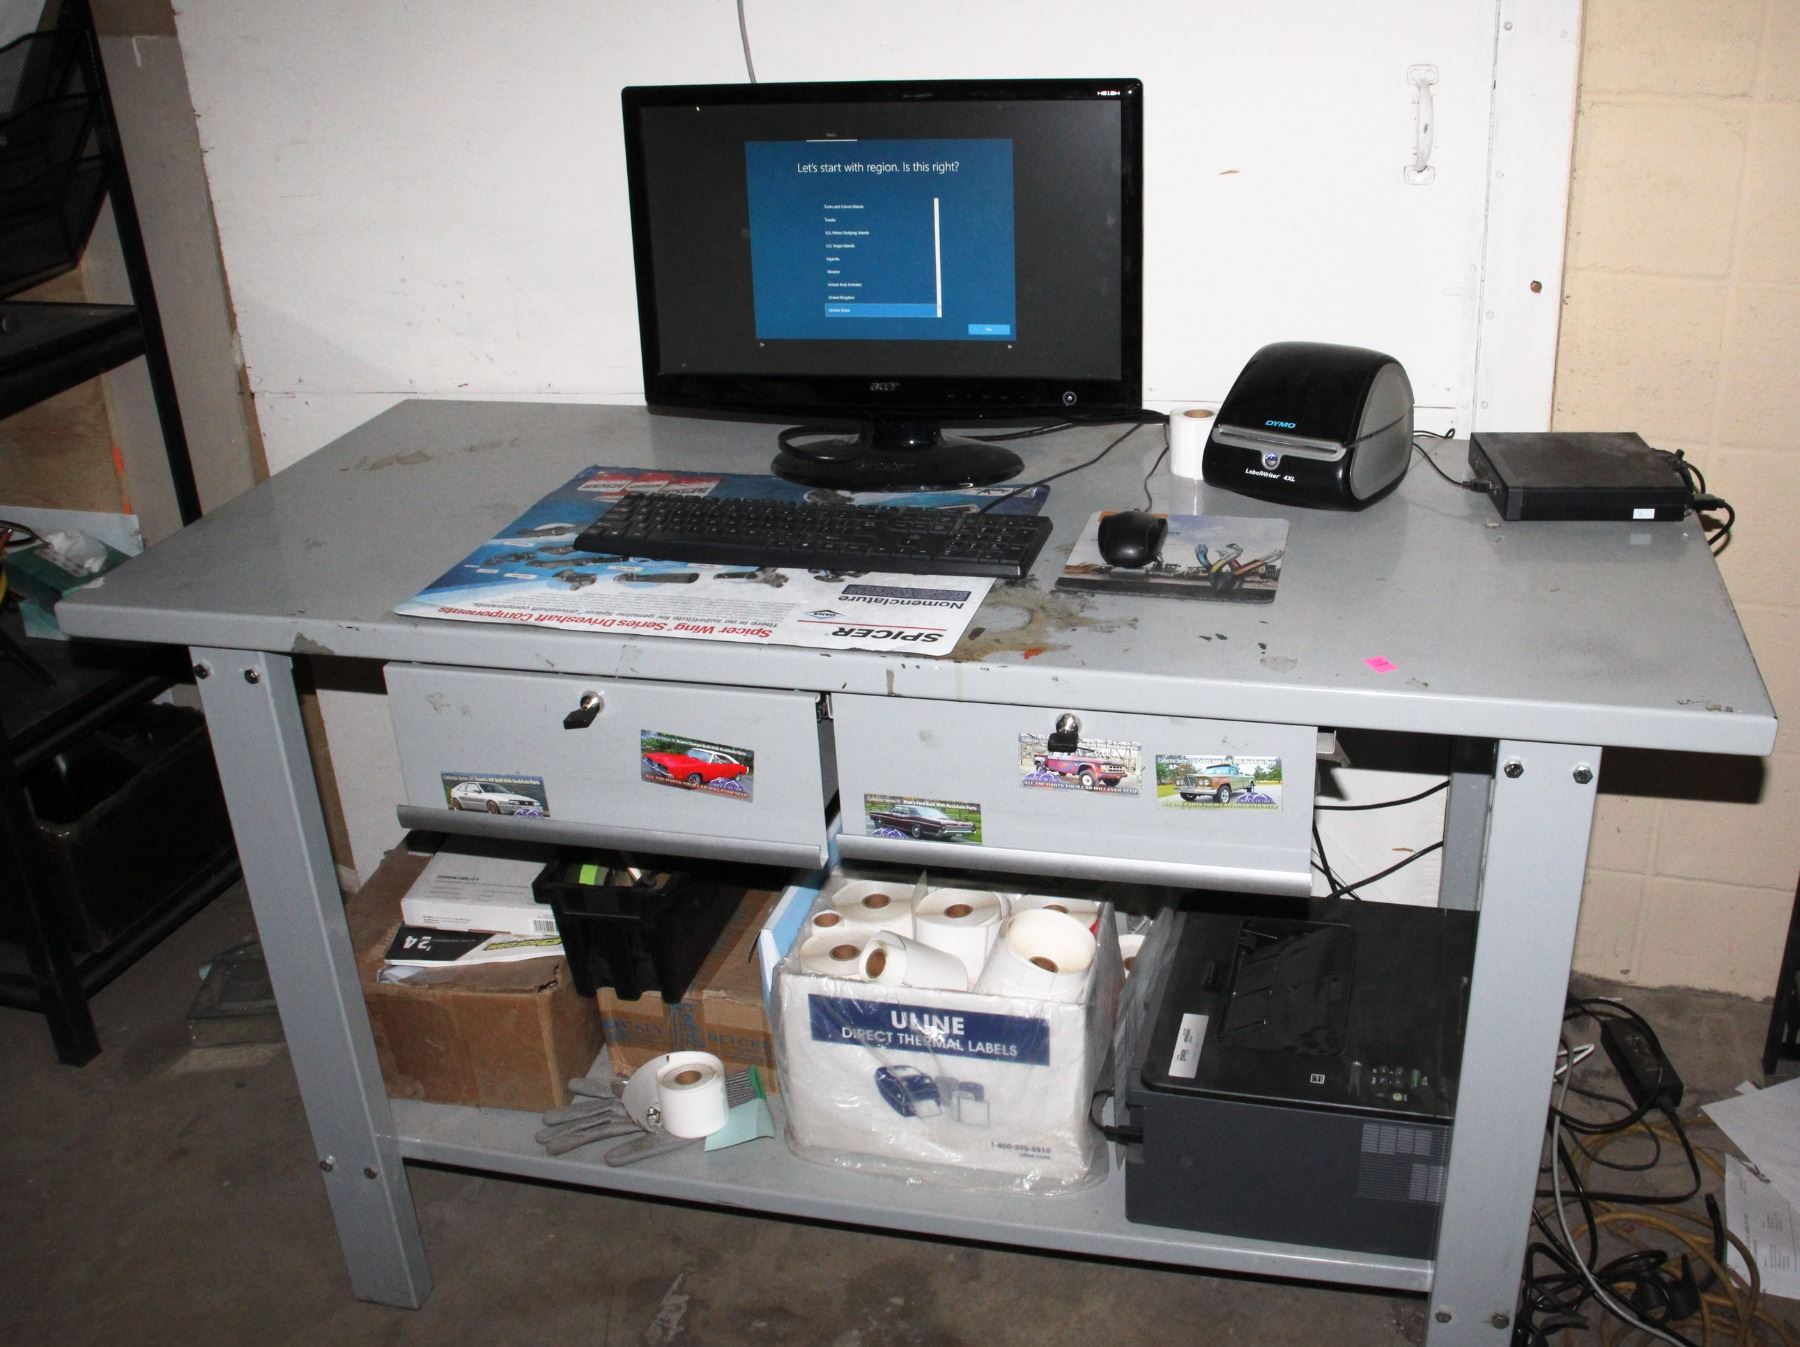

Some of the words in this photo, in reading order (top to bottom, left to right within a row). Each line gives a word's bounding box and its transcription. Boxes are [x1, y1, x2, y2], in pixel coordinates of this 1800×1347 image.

[796, 162, 818, 173] Let's
[820, 163, 842, 173] start
[843, 161, 864, 173] with
[866, 161, 900, 175] region.
[902, 161, 911, 173] Is
[912, 161, 930, 172] this
[932, 160, 960, 175] right?
[1264, 420, 1297, 429] DYMO
[1245, 468, 1280, 479] LabelWriter
[1283, 474, 1296, 483] 4XL
[838, 594, 965, 611] Nomenclature
[437, 606, 532, 622] Components
[534, 613, 616, 628] Driveshaft
[616, 619, 668, 631] Series
[717, 625, 773, 638] Spicer
[831, 627, 945, 643] SPICER
[890, 1010, 965, 1036] ULINE
[841, 1026, 893, 1043] DIRECT
[896, 1033, 964, 1052] THERMAL
[968, 1041, 1018, 1057] LABELS
